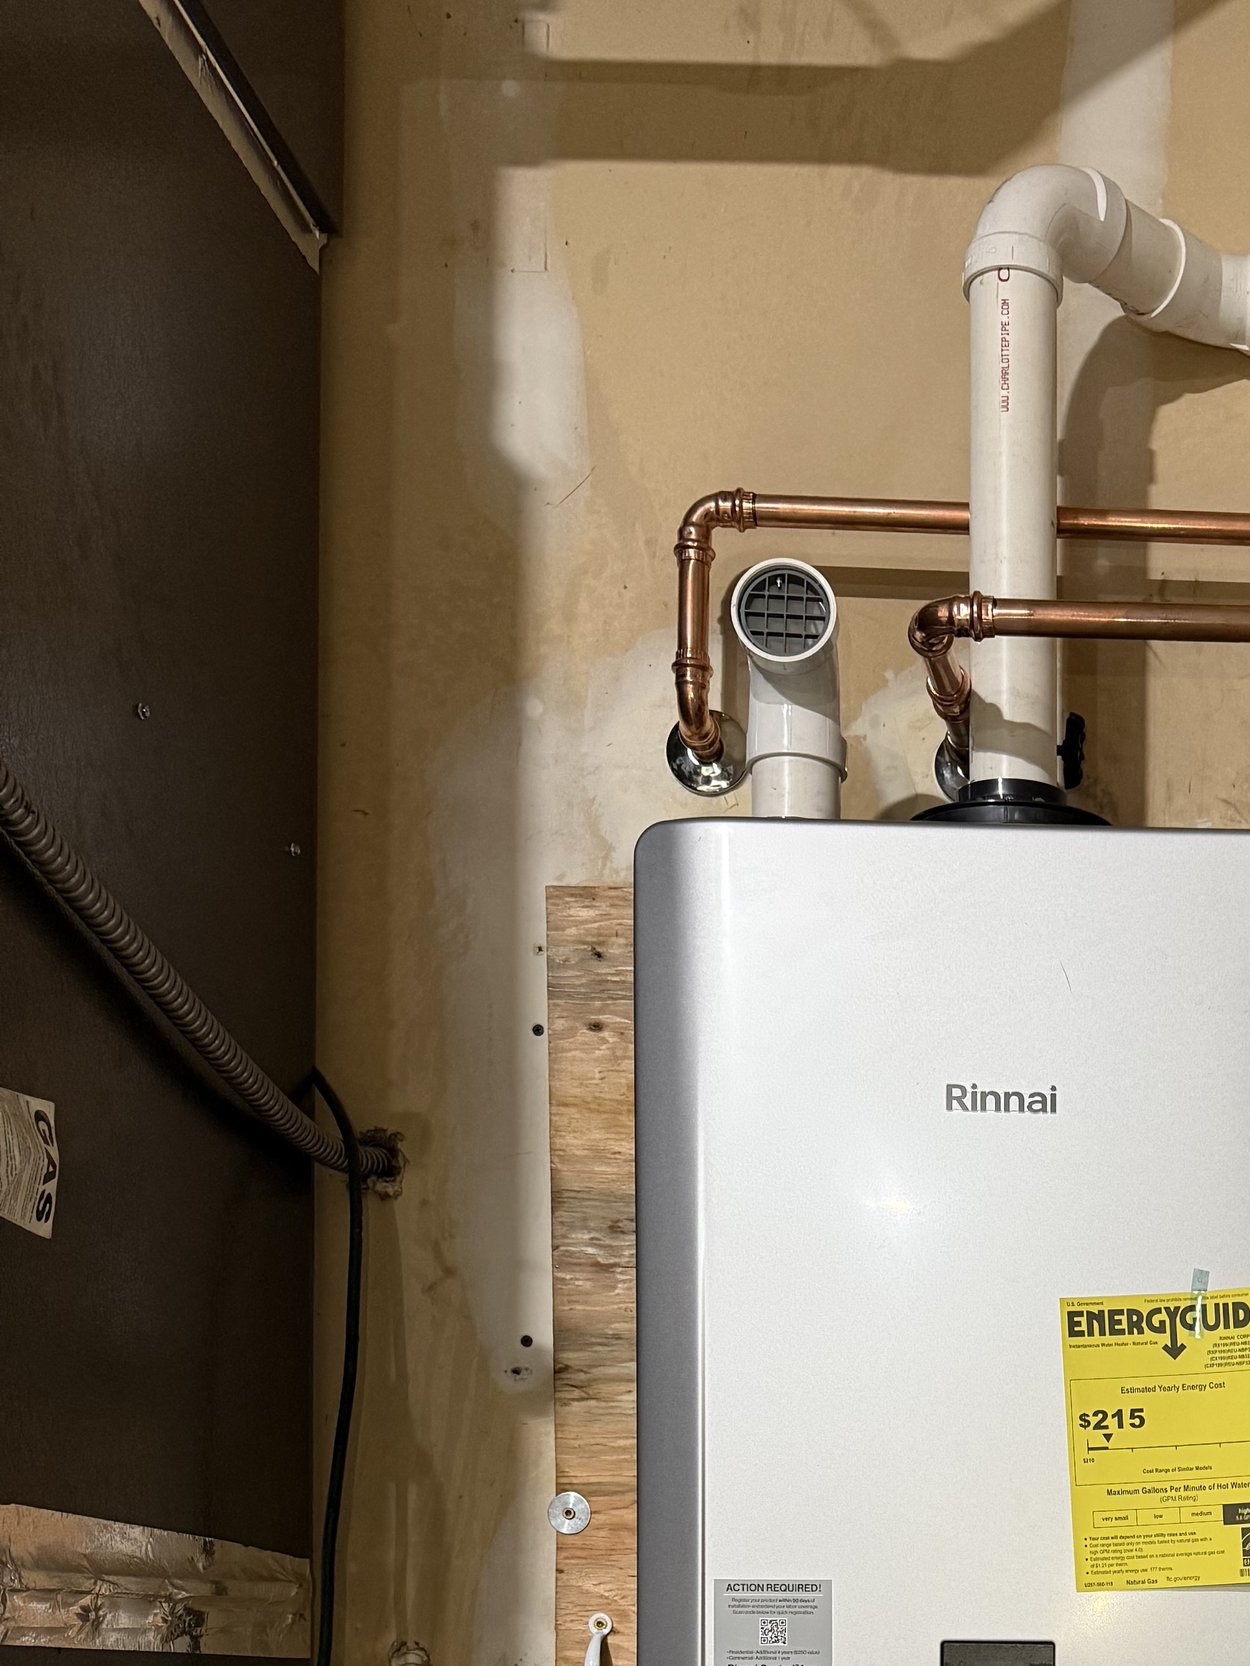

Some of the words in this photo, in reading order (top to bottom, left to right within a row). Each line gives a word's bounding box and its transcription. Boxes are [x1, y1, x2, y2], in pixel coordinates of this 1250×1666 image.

[1001, 299, 1009, 412] WWW.CHARLOTTEPIPE.COM
[946, 1083, 1057, 1114] Rinnai
[34, 1110, 57, 1224] GAS
[1121, 1385, 1156, 1394] Estimated
[1158, 1384, 1179, 1393] Yearly
[1182, 1383, 1207, 1392] Energy
[1209, 1381, 1225, 1389] Cost
[1079, 1408, 1146, 1430] $215
[1107, 1488, 1140, 1496] Maximum
[1142, 1486, 1168, 1495] Gallons
[1170, 1485, 1181, 1493] Per
[1183, 1484, 1207, 1492] Minute
[1231, 1481, 1250, 1489] Water
[1160, 1495, 1177, 1504] (GPM
[1178, 1494, 1199, 1502] Rating)
[1239, 1507, 1250, 1515] high
[726, 1583, 764, 1592] ACTION
[766, 1583, 821, 1592] REQUIRED!
